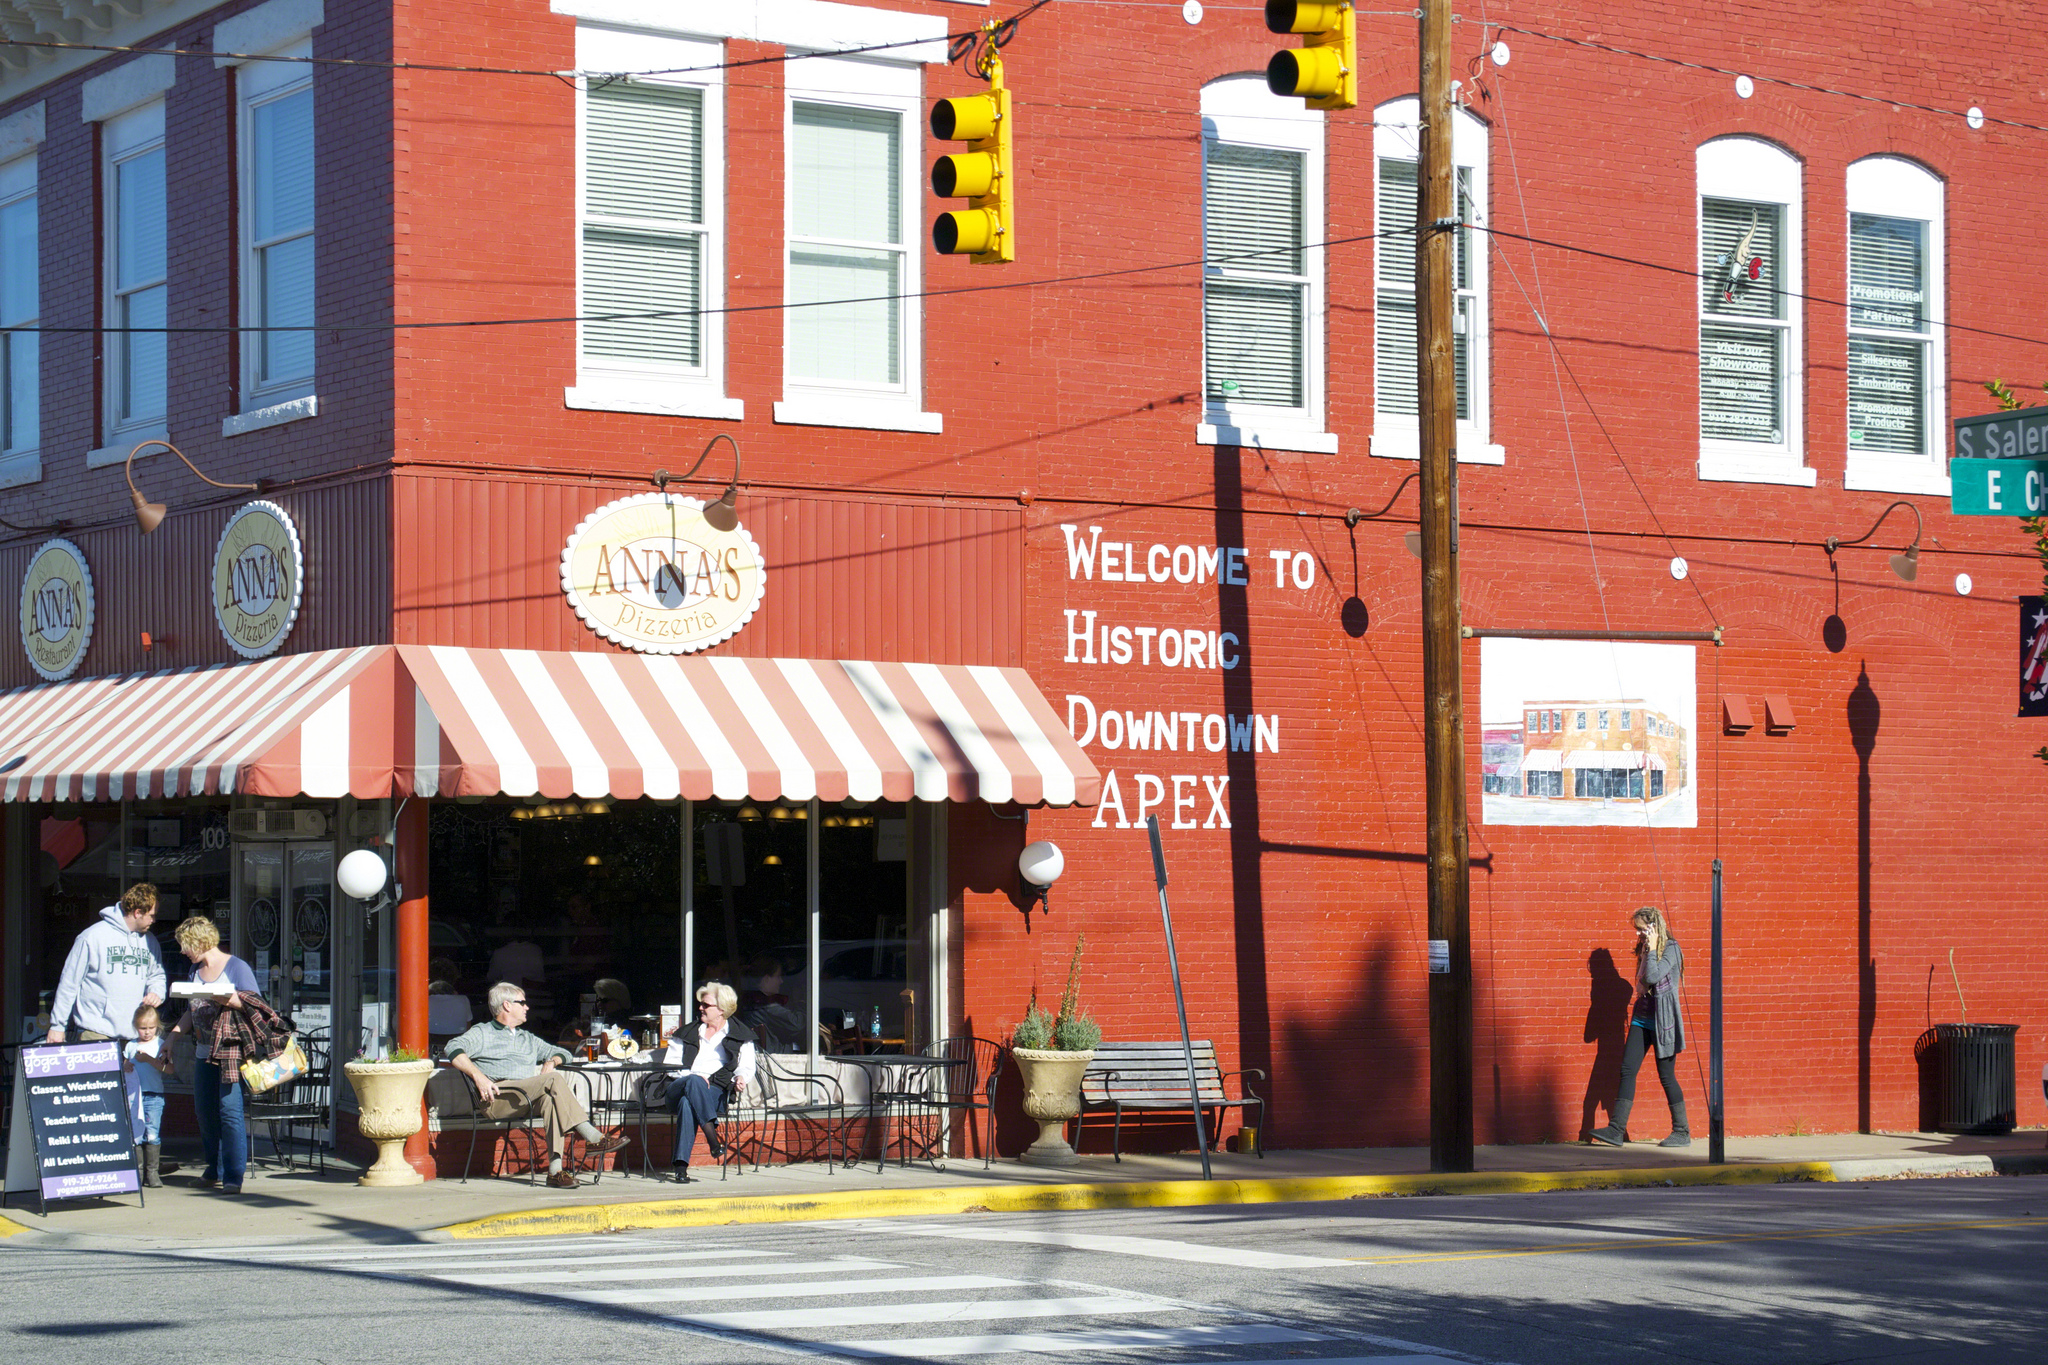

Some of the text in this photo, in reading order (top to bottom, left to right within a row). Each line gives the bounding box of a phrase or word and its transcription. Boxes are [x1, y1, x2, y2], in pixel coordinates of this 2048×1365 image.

[1853, 284, 1923, 302] Promotional
[1863, 308, 1914, 324] Partners
[1709, 356, 1770, 371] Showroom
[1861, 353, 1909, 368] Silkscreen
[1858, 377, 1911, 393] Embroidery
[1856, 401, 1913, 416] Promotional
[1865, 415, 1906, 429] Products
[1958, 426, 1974, 459] S
[1987, 469, 2002, 510] E
[1060, 523, 1315, 590] WELCOME TO
[223, 546, 288, 610] ANNA'S
[588, 544, 741, 602] ANNA'S
[28, 580, 81, 636] ANNA'S
[234, 611, 279, 644] Pizzeria
[612, 601, 718, 639] Pizzeria
[1063, 608, 1240, 670] HISTORIC
[35, 635, 77, 666] Restaurant
[1065, 694, 1280, 754] DOWNTOWN
[1091, 768, 1232, 830] APEX
[200, 826, 225, 850] 100
[215, 909, 231, 919] BEST
[106, 945, 127, 956] NEW
[23, 1050, 118, 1075] yoga garden
[31, 1080, 118, 1096] Classes, Workshops
[52, 1093, 101, 1105] & Retreats
[43, 1112, 116, 1126] Teacher Training
[47, 1132, 119, 1146] Reiki & Massage
[43, 1150, 130, 1168] All Levels Welcome!
[56, 1182, 126, 1196] yogagardennc.com
[62, 1173, 118, 1187] 919-267-9264
